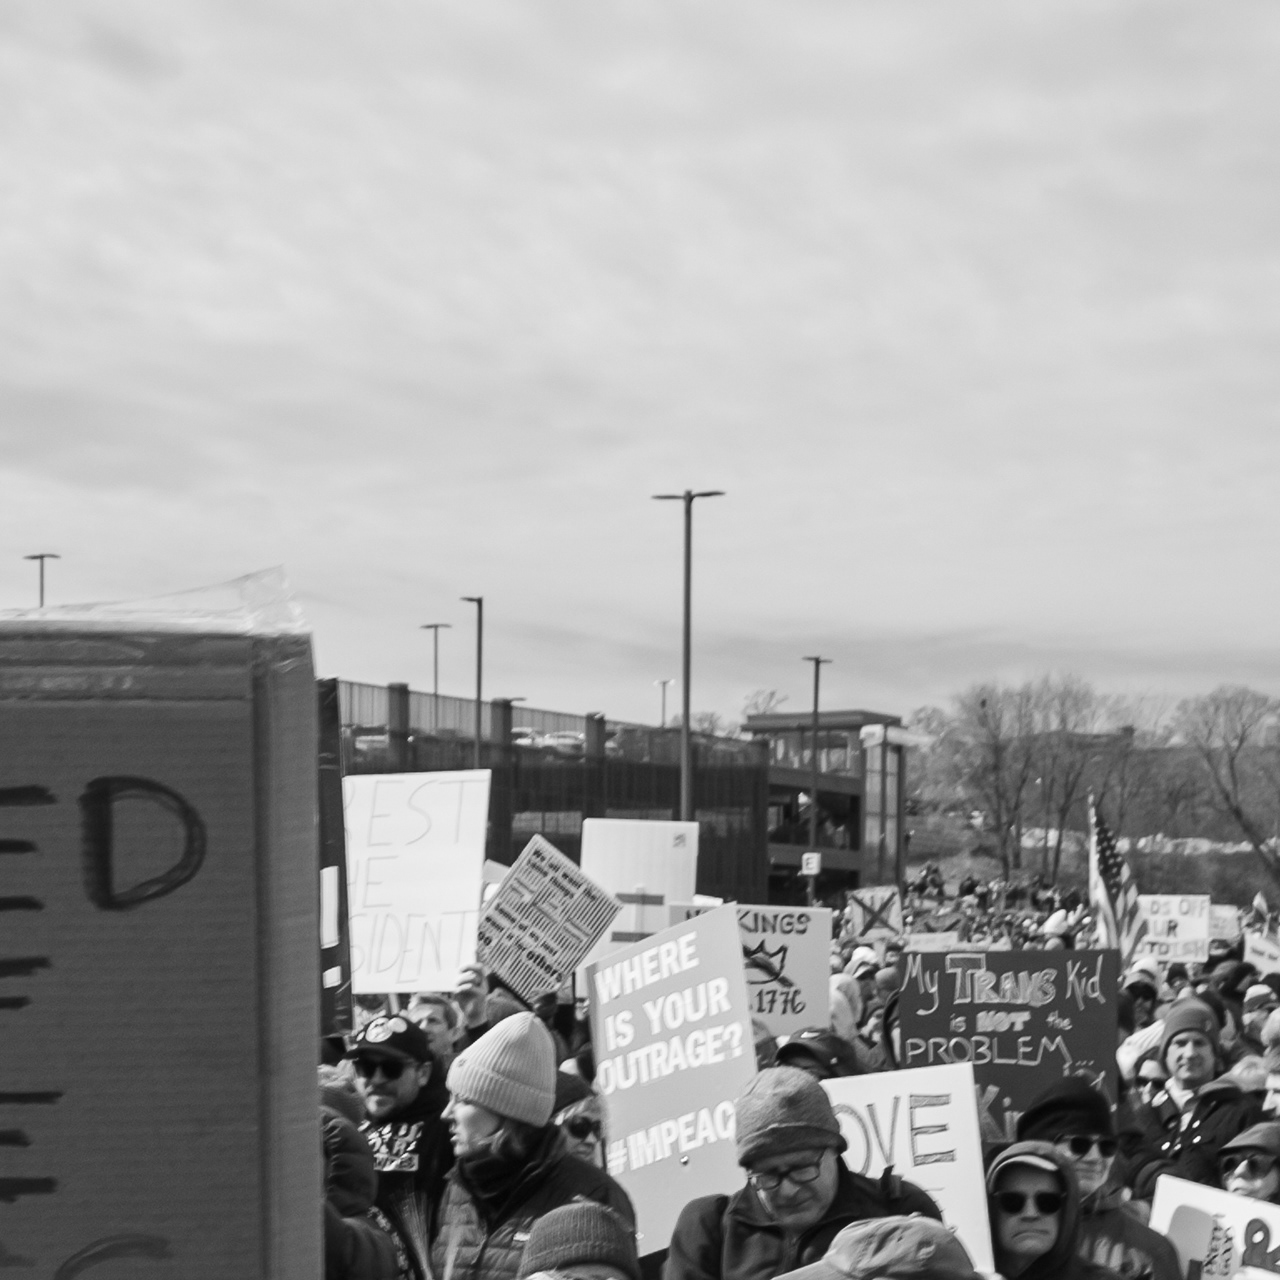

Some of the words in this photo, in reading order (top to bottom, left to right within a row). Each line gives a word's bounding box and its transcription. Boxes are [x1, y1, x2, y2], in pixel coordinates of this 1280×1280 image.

[738, 909, 812, 935] KINGS
[595, 931, 700, 1005] WHERE
[756, 988, 807, 1016] 1776
[900, 953, 939, 1015] My
[945, 952, 1058, 1008] TRANS
[1066, 954, 1107, 1011] Kid
[604, 1010, 635, 1052] IS
[643, 977, 733, 1035] YOUR
[950, 1013, 967, 1033] is
[976, 1010, 1032, 1033] NOT
[1045, 1010, 1073, 1031] the
[596, 1021, 743, 1095] OUTRAGE?
[606, 1099, 737, 1177] #IMPEAC
[832, 1092, 957, 1176] OVE
